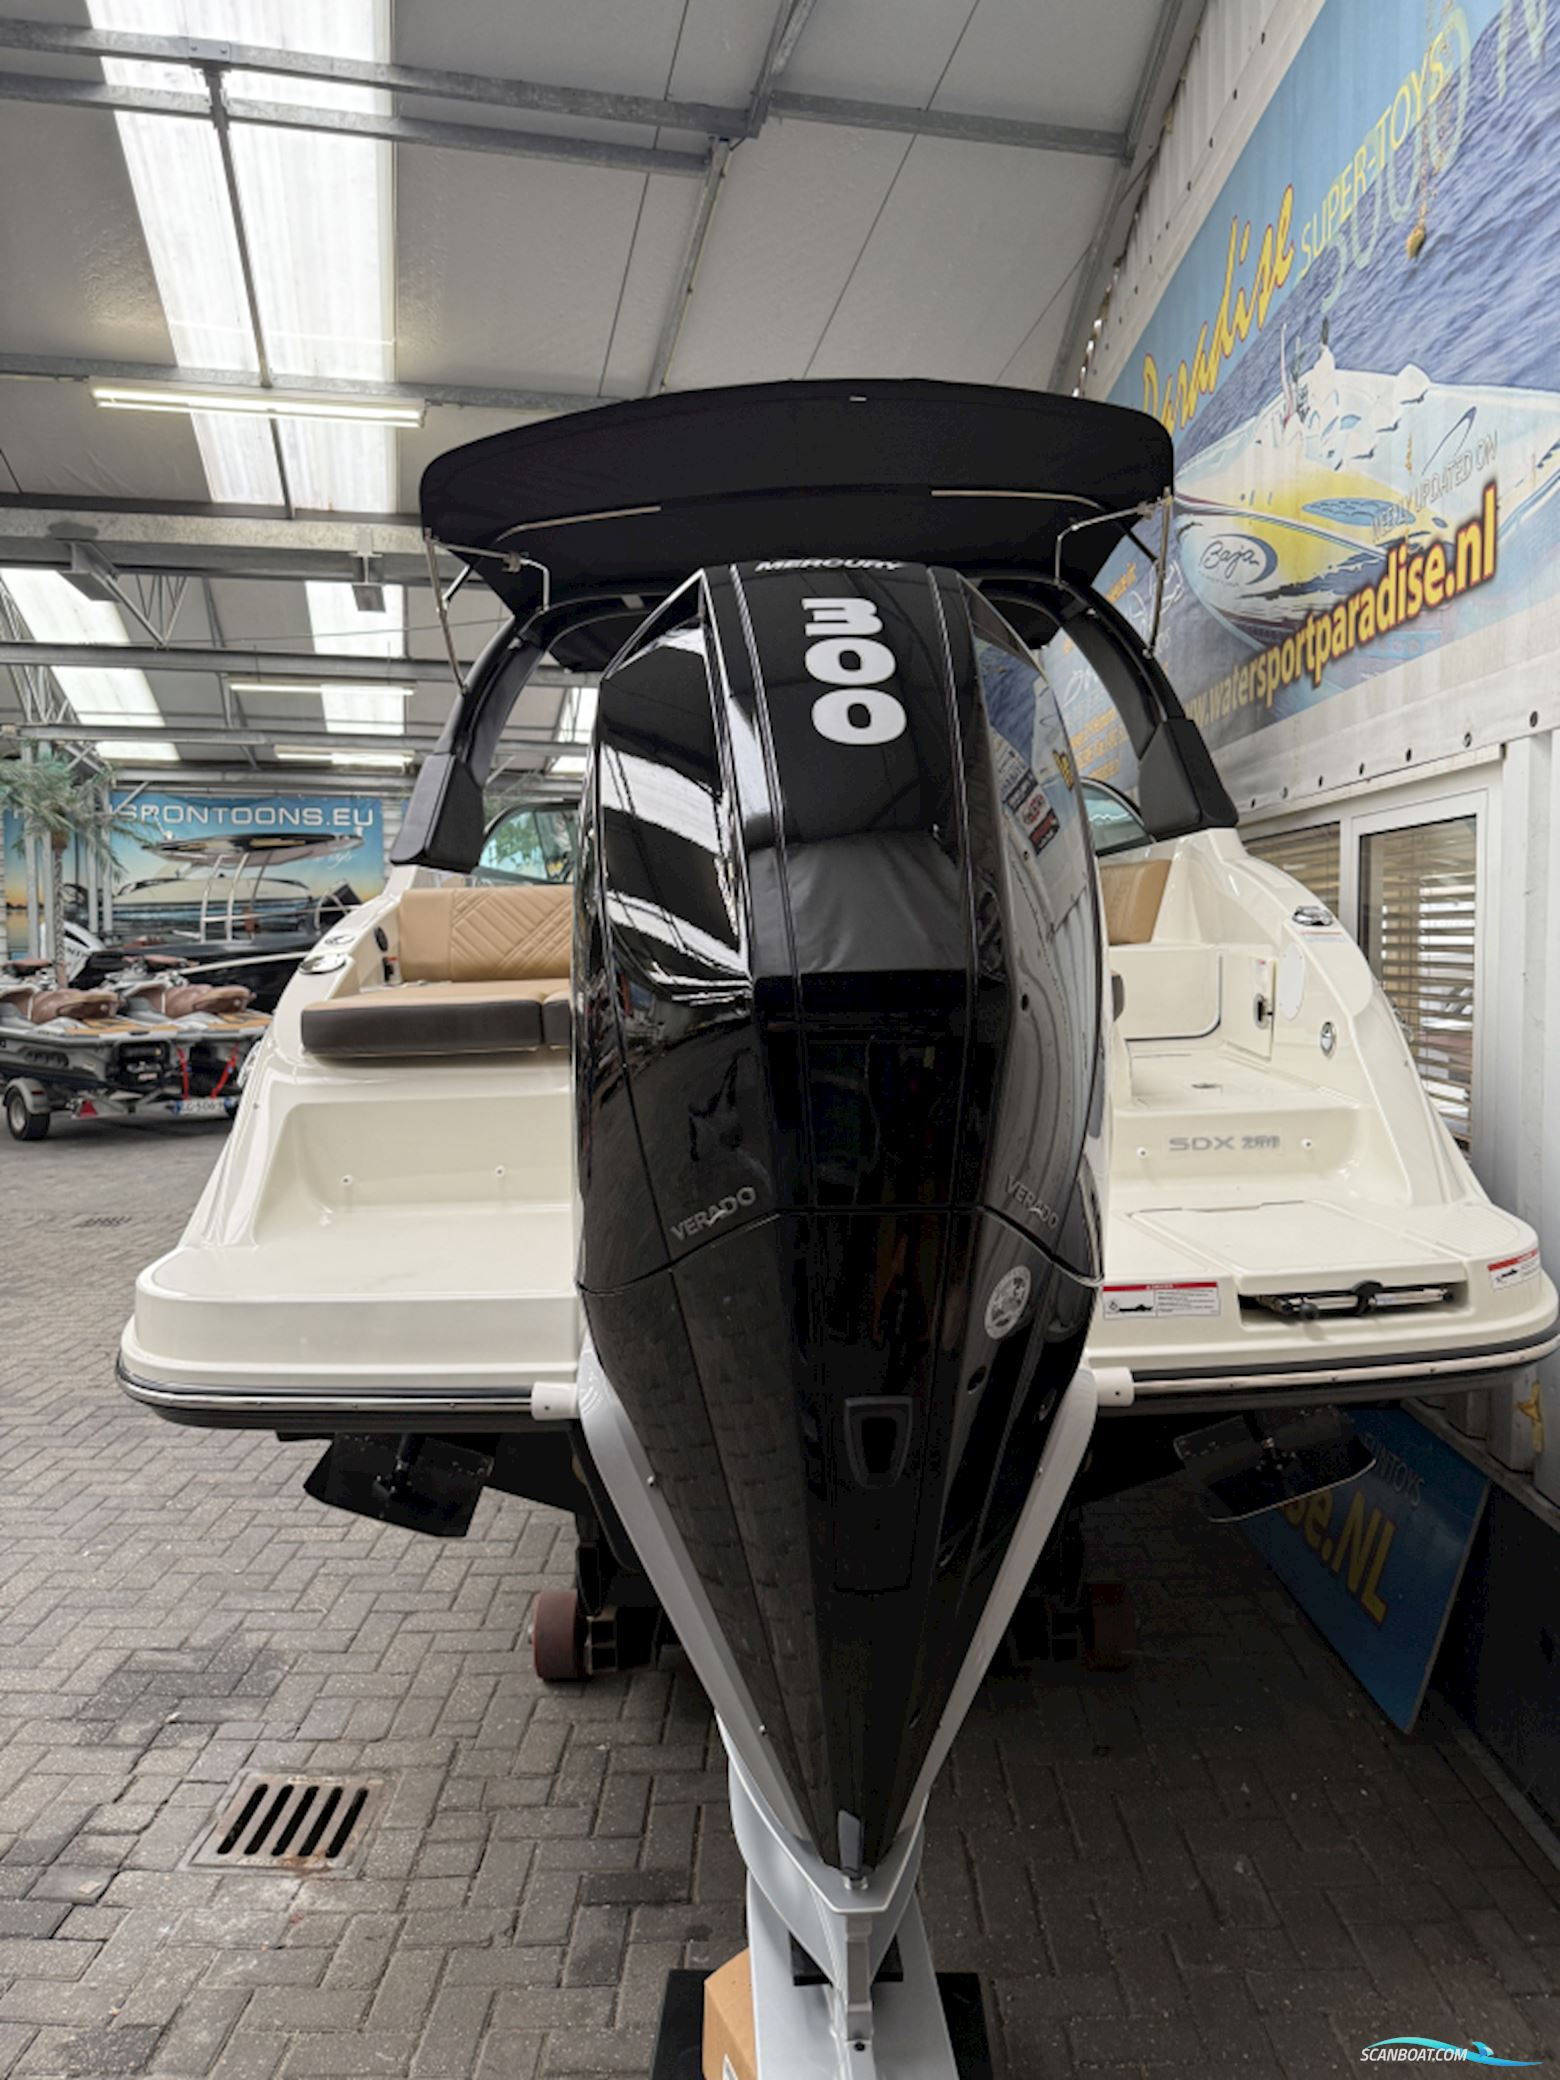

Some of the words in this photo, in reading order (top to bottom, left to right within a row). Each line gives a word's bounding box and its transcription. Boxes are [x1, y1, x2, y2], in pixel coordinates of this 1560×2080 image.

[754, 557, 905, 572] MERCURY
[1201, 540, 1260, 580] Baja
[801, 597, 907, 745] 300
[1168, 1136, 1235, 1152] SDX
[670, 1186, 757, 1241] VERADO
[1005, 1175, 1060, 1229] VERADO
